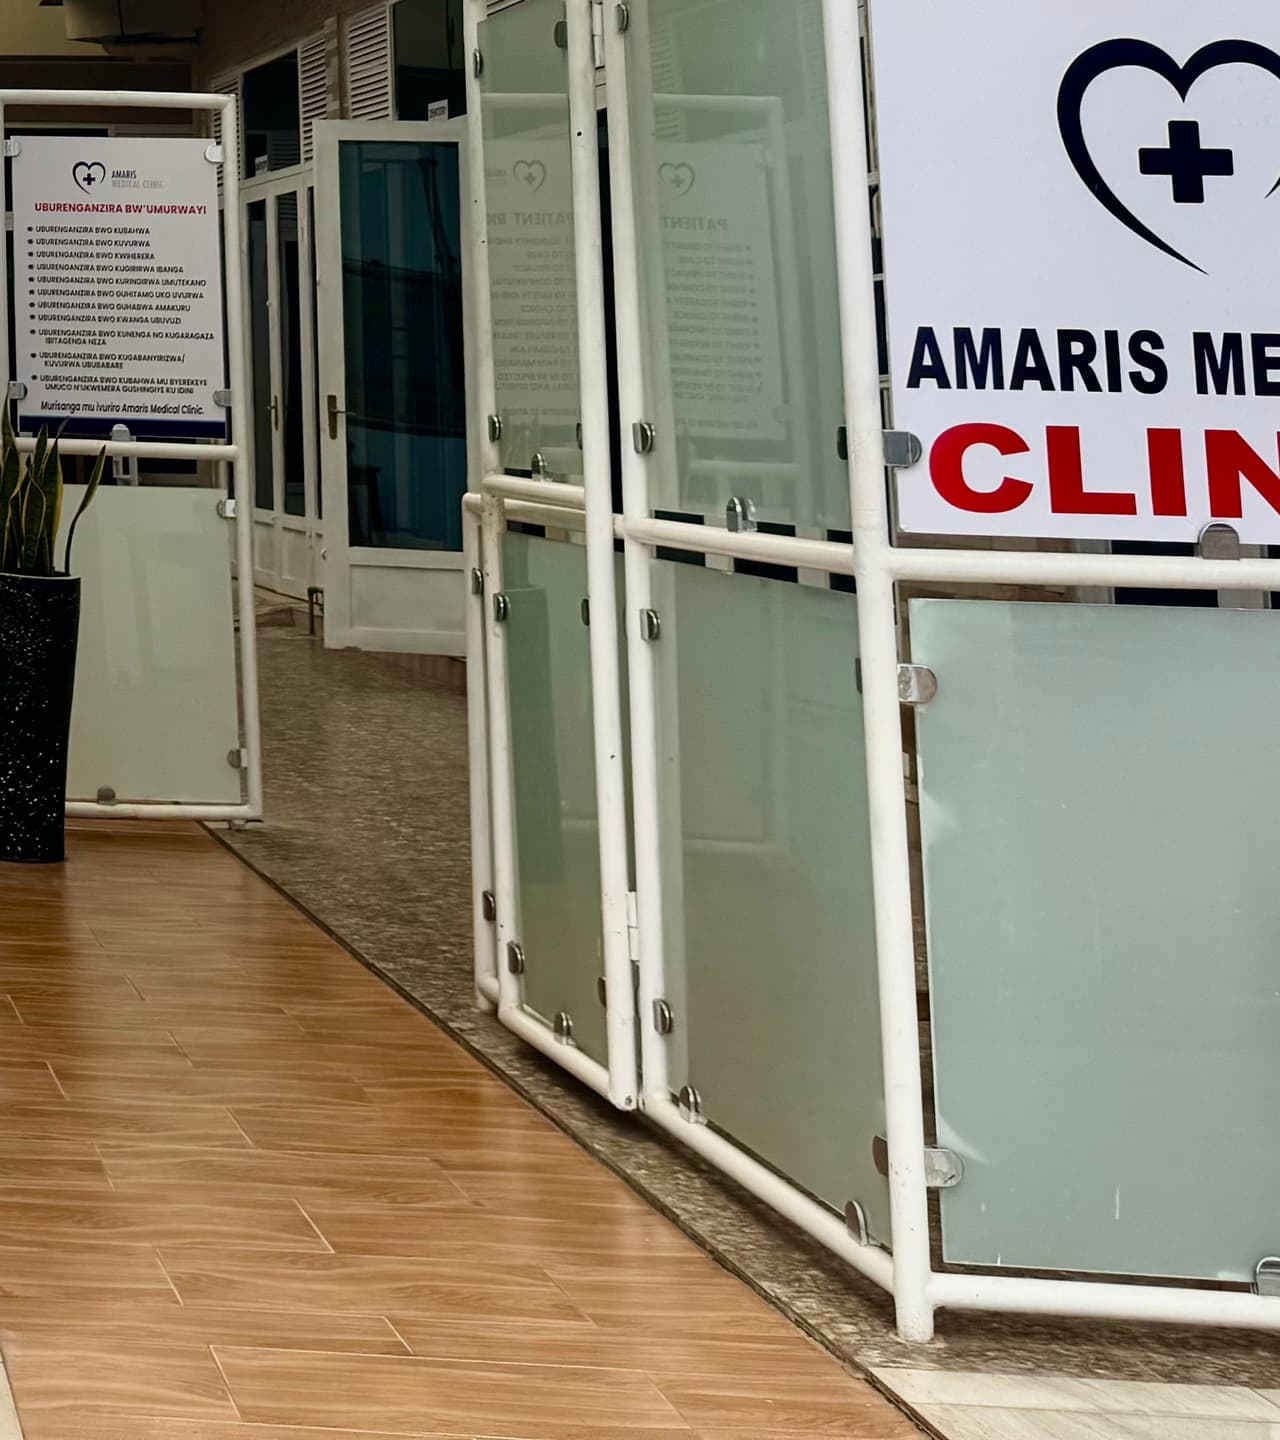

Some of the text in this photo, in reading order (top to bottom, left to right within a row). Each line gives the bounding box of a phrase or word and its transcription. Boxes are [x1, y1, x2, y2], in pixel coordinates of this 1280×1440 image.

[111, 170, 137, 179] AMARIS
[34, 202, 207, 215] UBURENGANZIRA BW'UMURWAYI
[906, 326, 1280, 396] AMARIS ME
[929, 422, 1280, 518] CLIN
